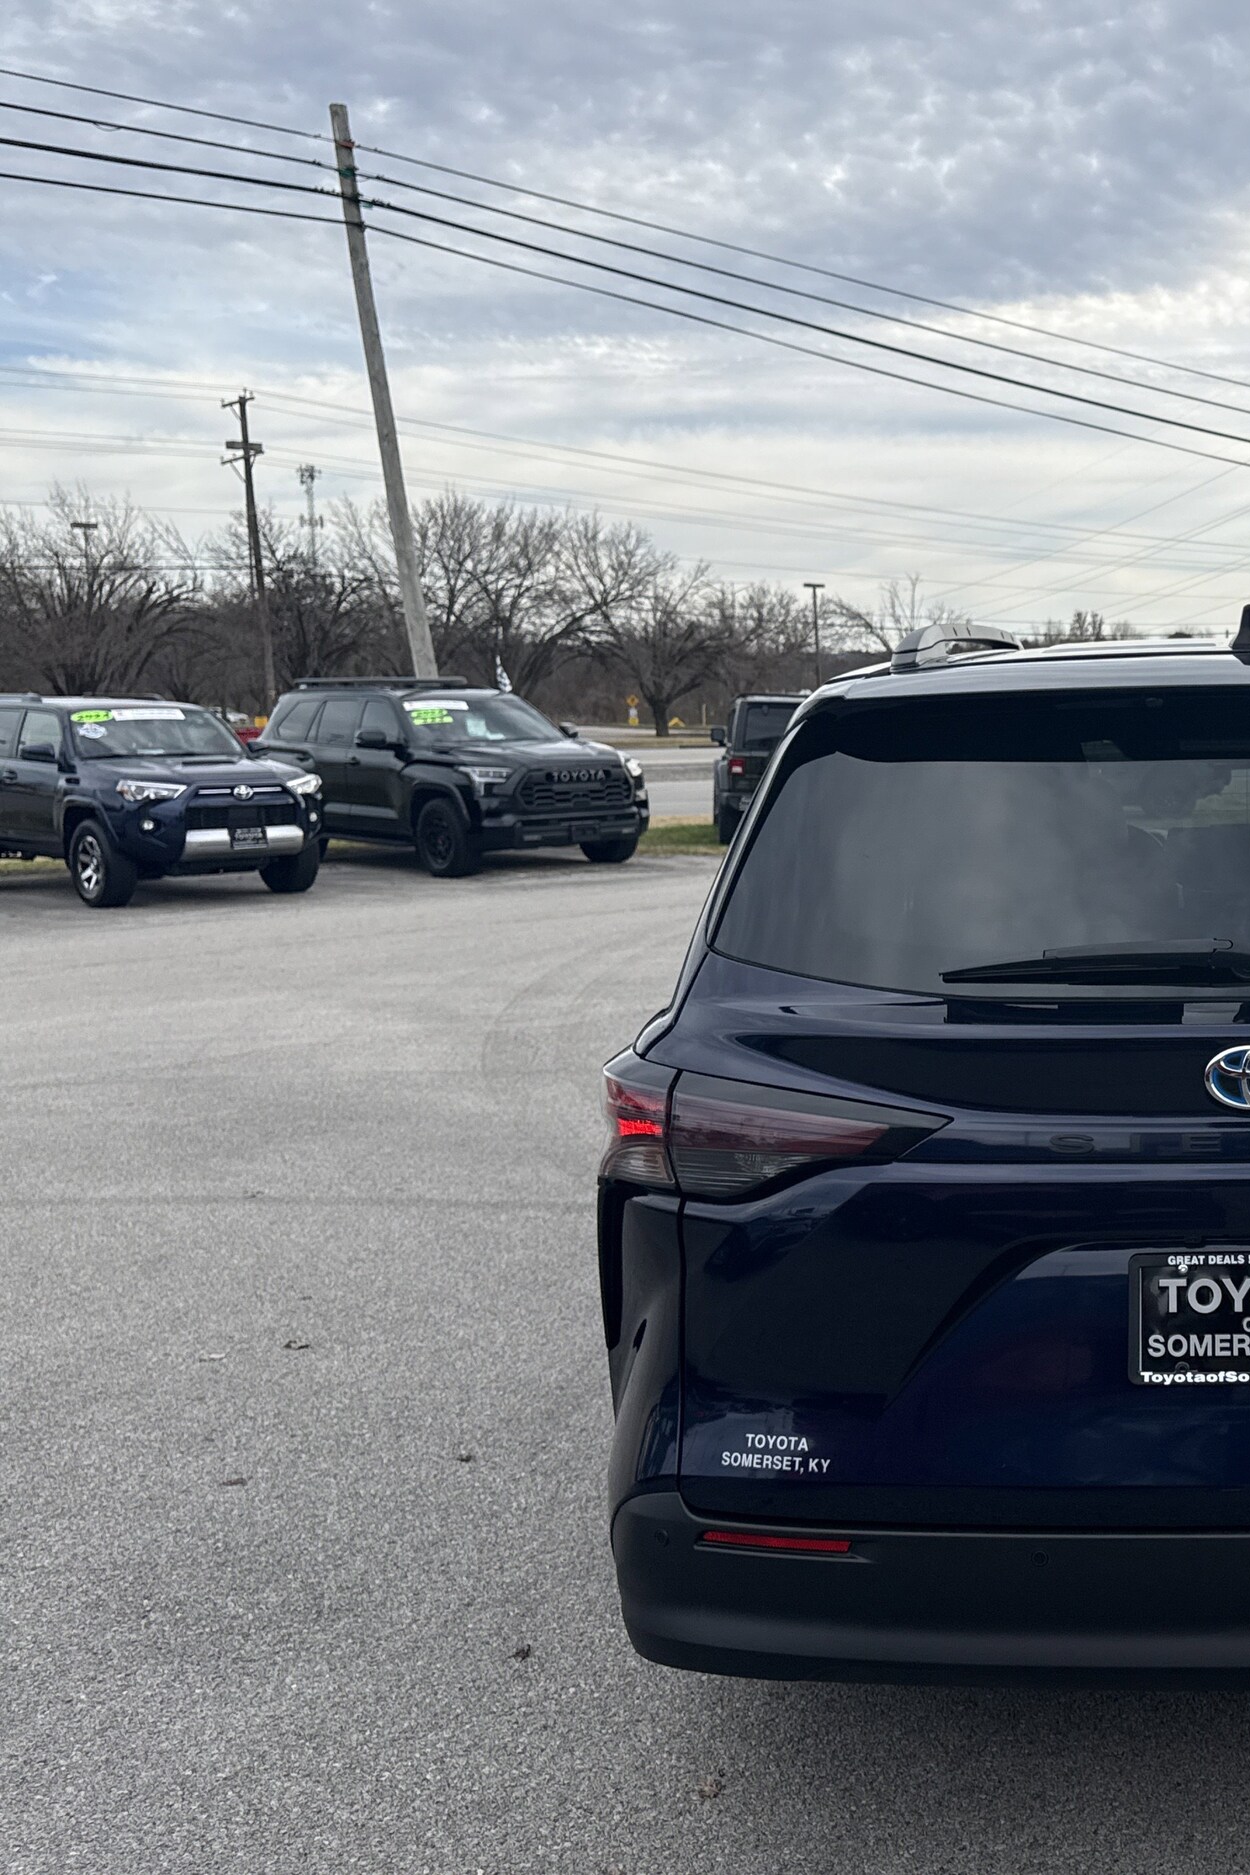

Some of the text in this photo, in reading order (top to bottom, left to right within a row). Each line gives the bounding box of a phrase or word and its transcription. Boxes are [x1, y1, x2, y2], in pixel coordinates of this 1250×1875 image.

[552, 769, 605, 782] TOYOTA
[1167, 1255, 1205, 1265] GREAT
[745, 1433, 809, 1452] TOYOTA
[721, 1451, 831, 1475] SOMERSET, KY
